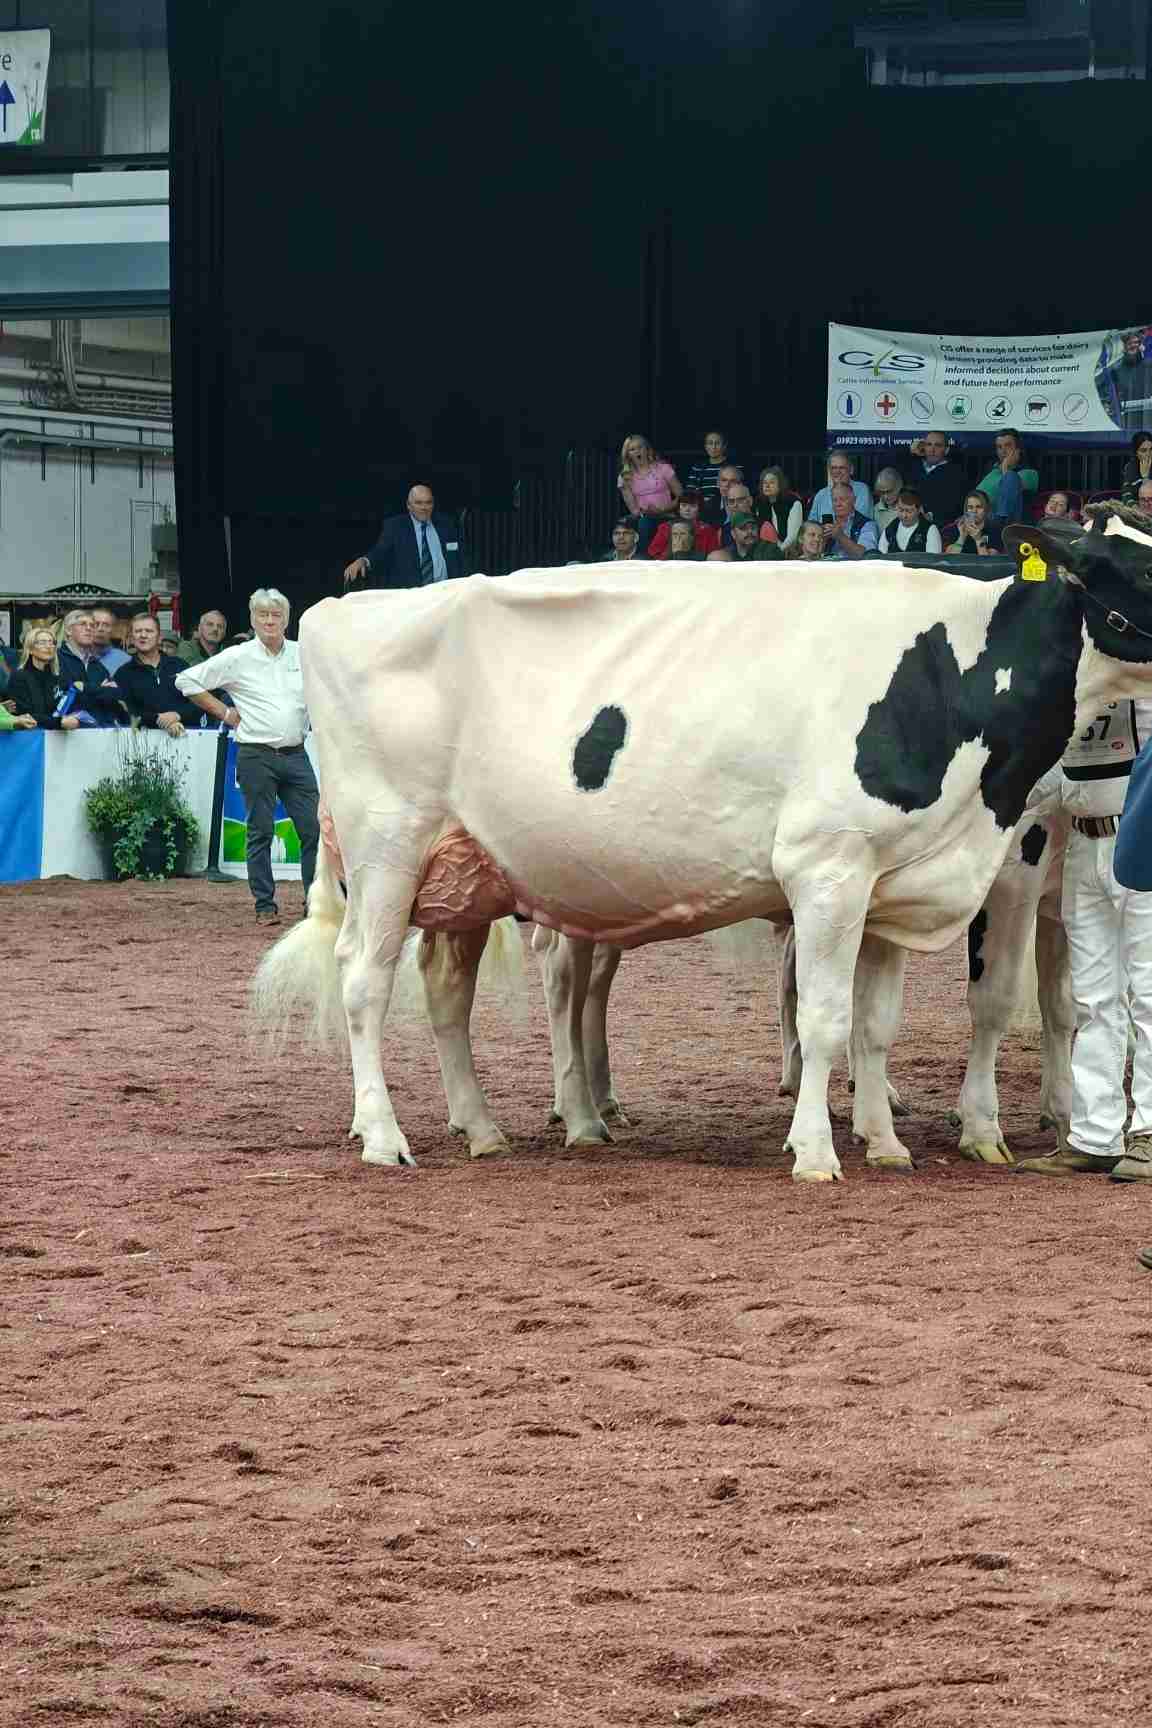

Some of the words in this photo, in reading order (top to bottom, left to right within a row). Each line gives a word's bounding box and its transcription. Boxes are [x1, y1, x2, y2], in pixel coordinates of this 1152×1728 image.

[954, 344, 973, 352] offer
[982, 346, 1006, 354] range
[1018, 343, 1051, 352] services
[1066, 342, 1089, 351] dairy
[977, 355, 1017, 365] providing
[1050, 352, 1074, 360] make
[945, 365, 984, 374] informed
[986, 365, 1025, 374] decisions
[1026, 365, 1049, 374] about
[1050, 365, 1080, 373] current
[961, 379, 988, 387] future
[989, 379, 1008, 387] herd
[1010, 378, 1062, 389] performance
